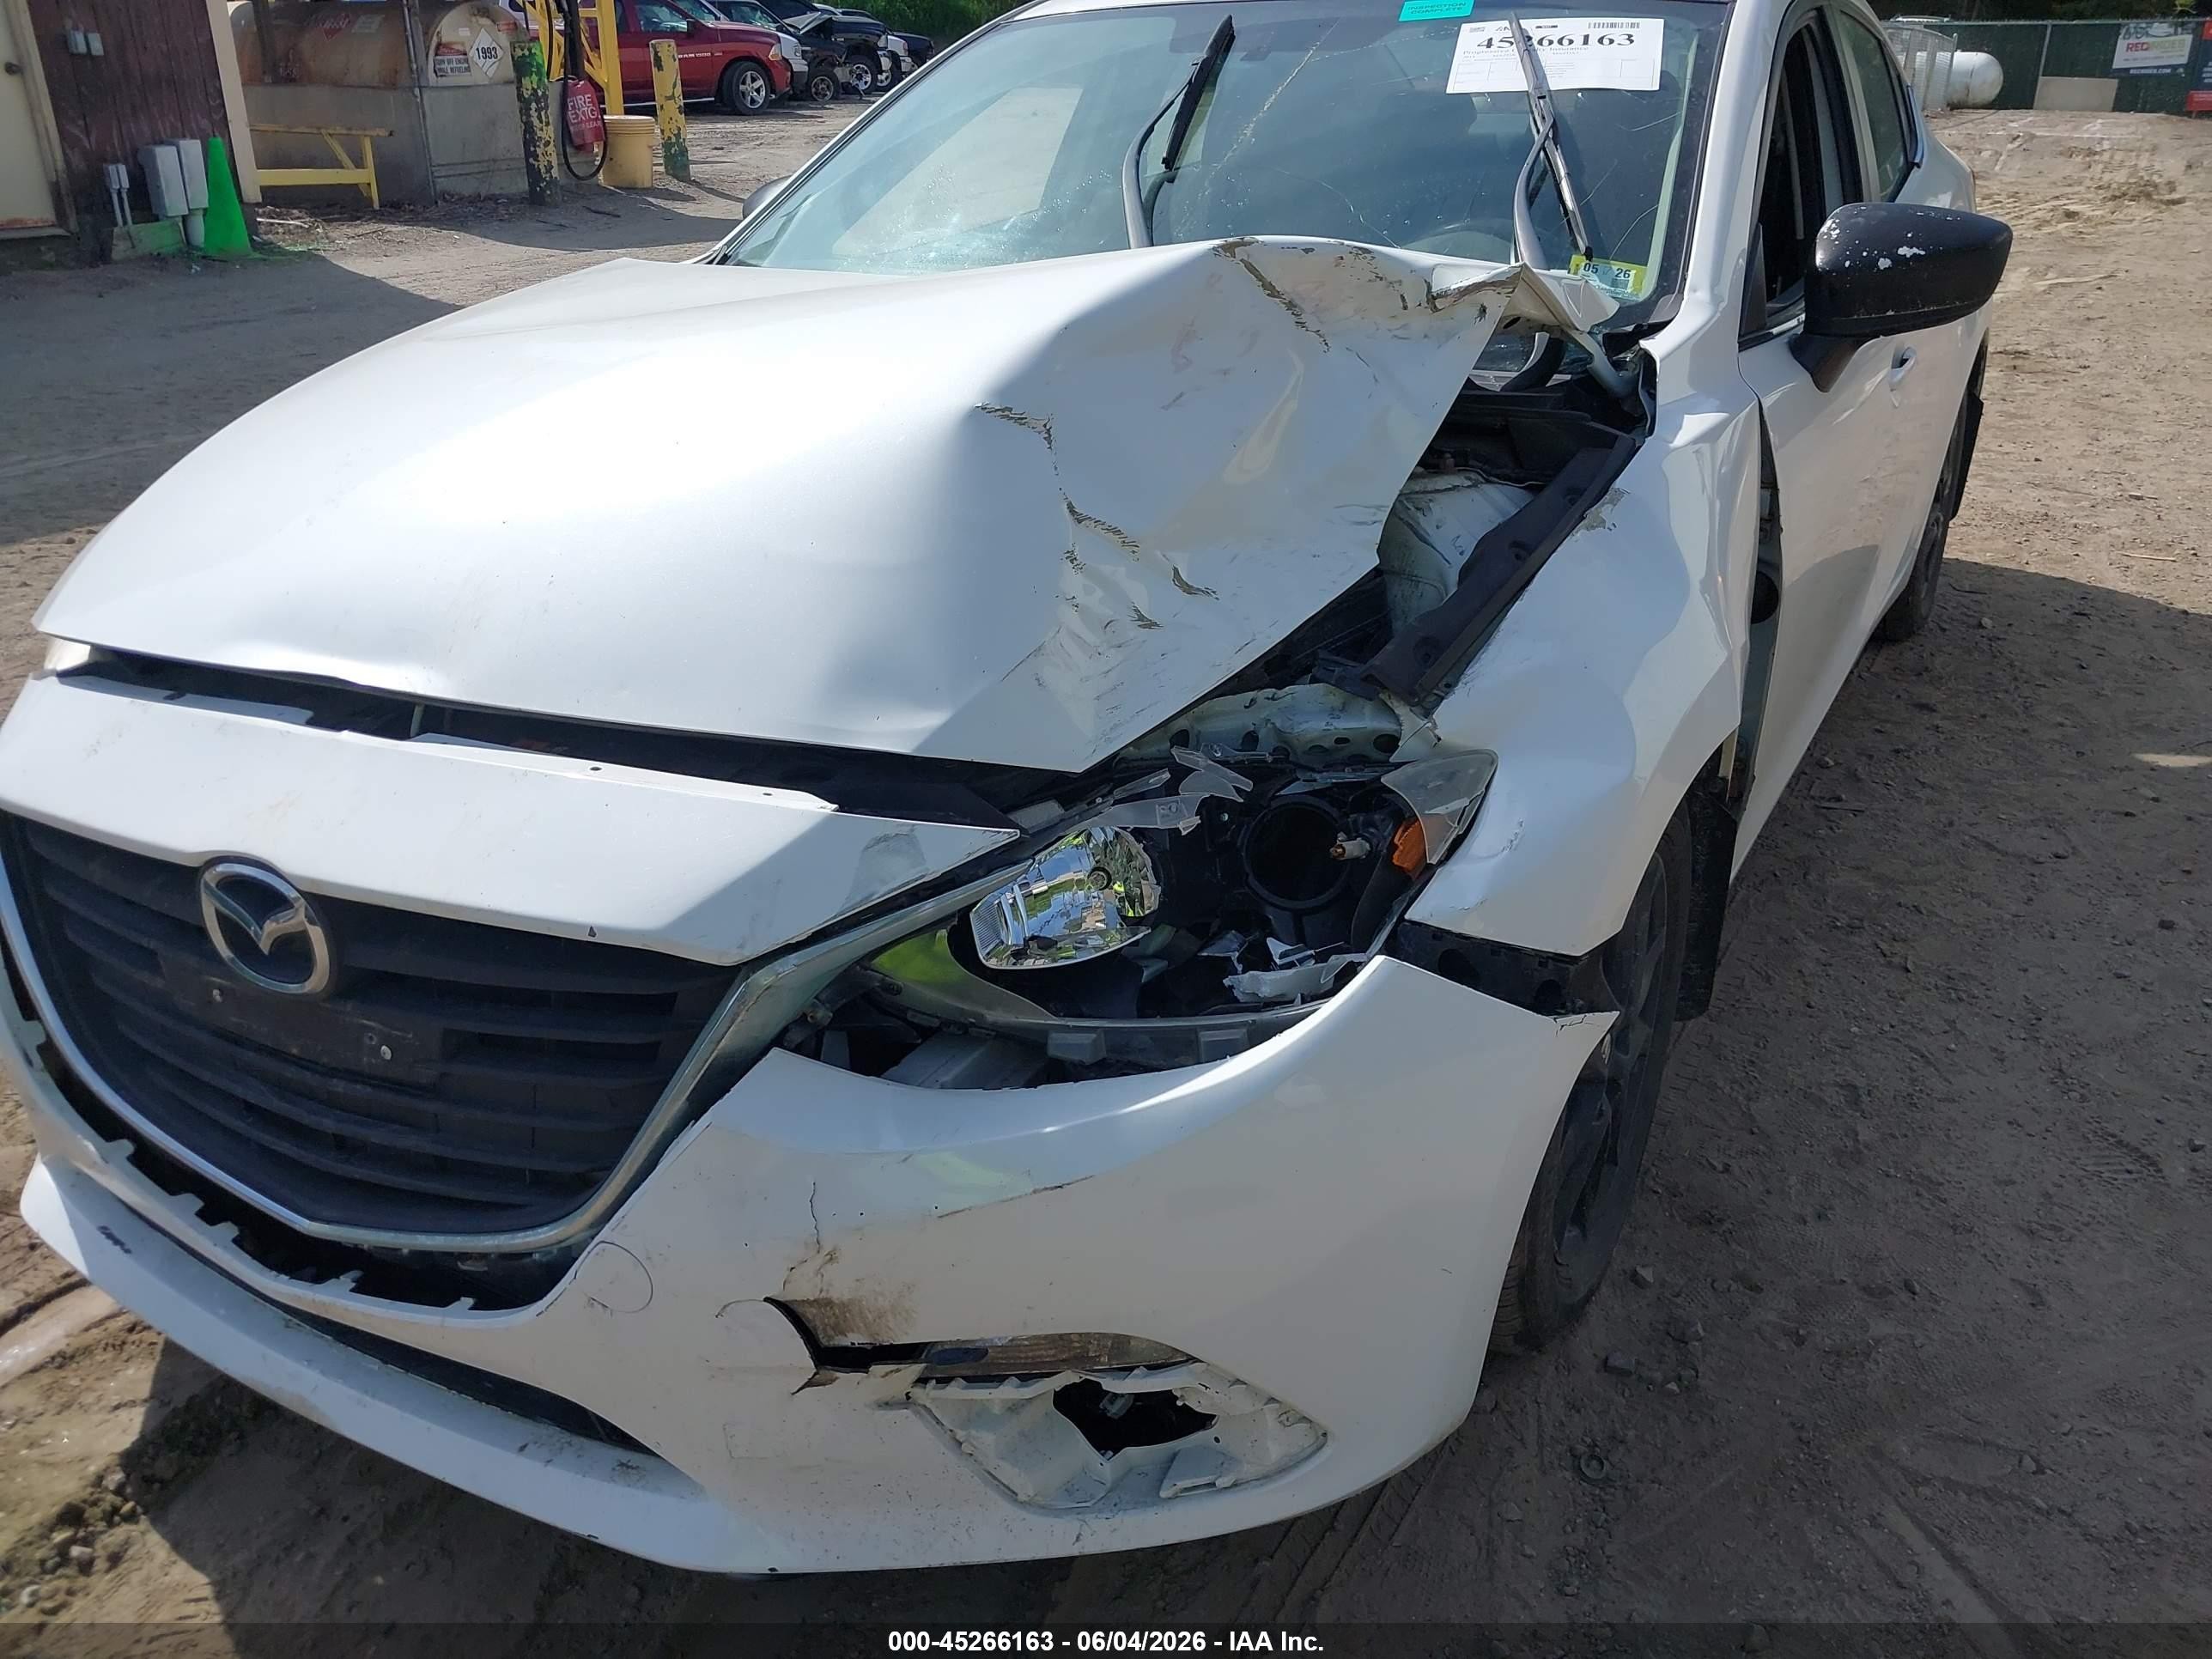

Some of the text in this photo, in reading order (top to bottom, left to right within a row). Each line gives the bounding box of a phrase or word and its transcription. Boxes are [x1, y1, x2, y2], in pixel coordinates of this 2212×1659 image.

[476, 46, 498, 60] 1993
[568, 94, 592, 110] FIRE
[1583, 263, 1631, 278] 05 26
